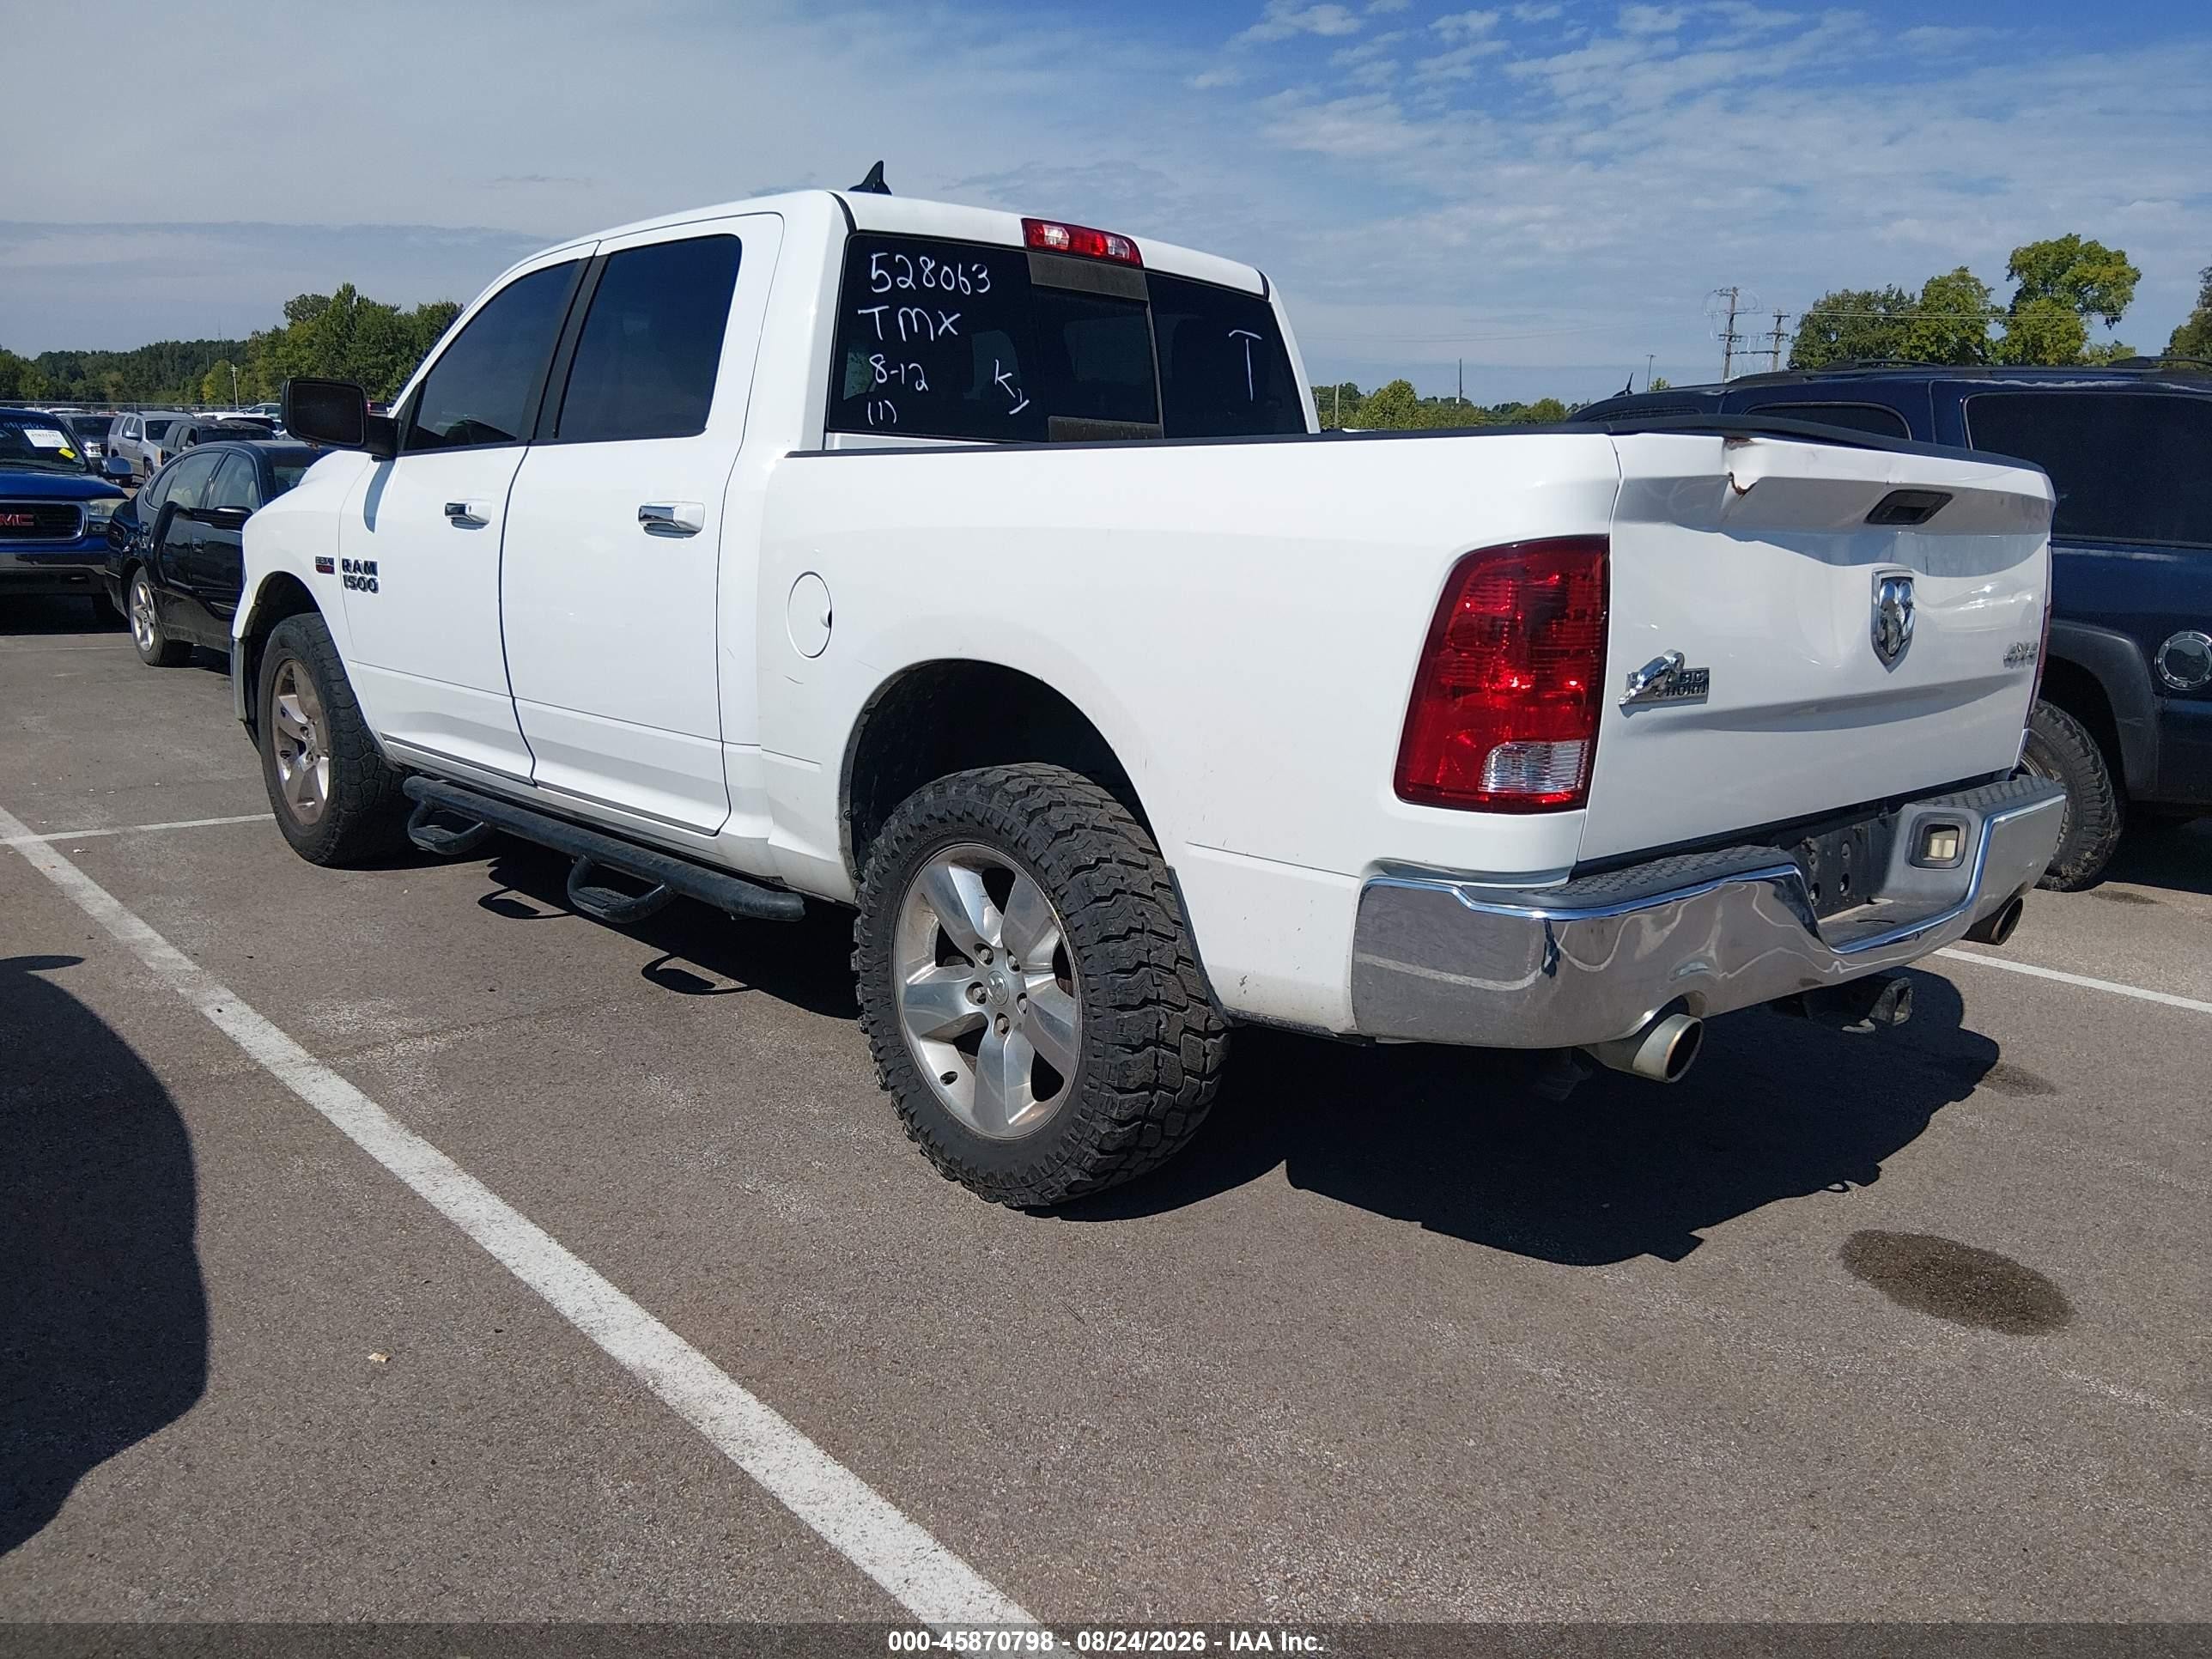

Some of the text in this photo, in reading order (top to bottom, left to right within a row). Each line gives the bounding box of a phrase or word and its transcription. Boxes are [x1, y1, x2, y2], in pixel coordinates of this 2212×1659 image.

[871, 252, 991, 295] 528063
[869, 353, 929, 392] 8-12
[1228, 329, 1263, 402] T
[0, 514, 34, 526] MC
[342, 557, 378, 577] RAM
[343, 574, 380, 594] 1500
[1666, 684, 1707, 697] HORN
